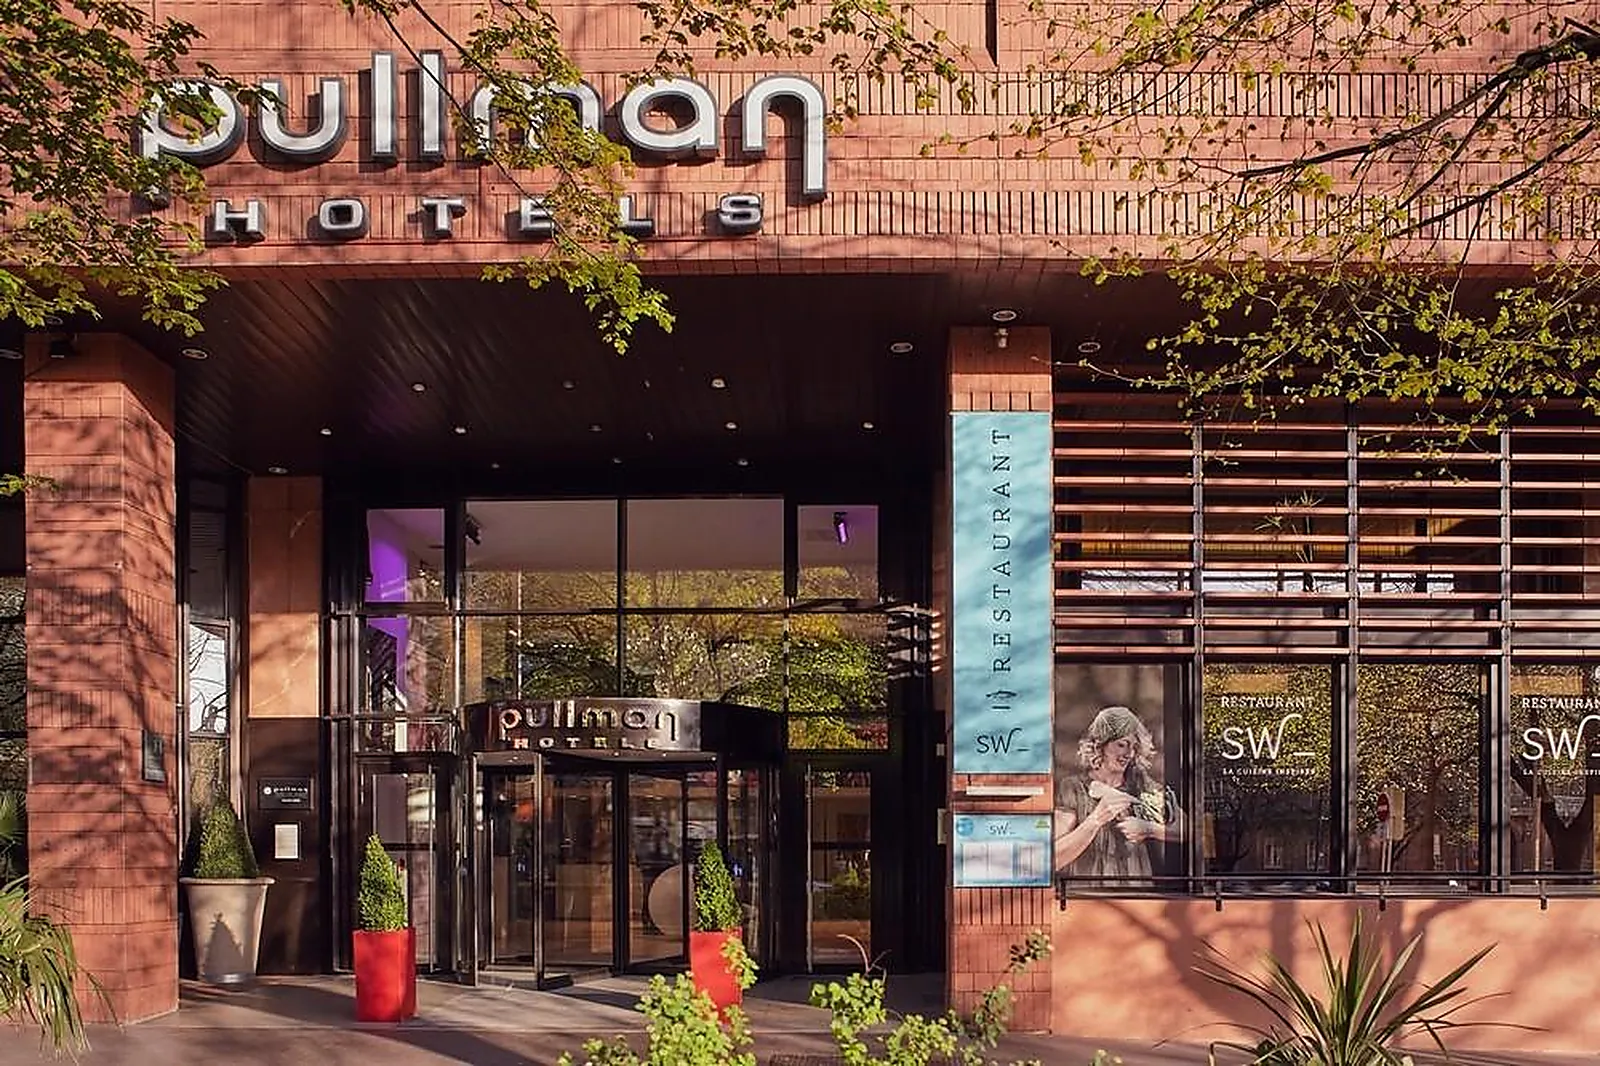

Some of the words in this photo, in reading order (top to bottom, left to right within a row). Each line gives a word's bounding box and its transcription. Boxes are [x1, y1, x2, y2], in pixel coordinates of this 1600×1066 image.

[139, 50, 826, 204] pullman
[213, 193, 763, 237] HOTELS
[992, 429, 1011, 673] RESTAURANT
[499, 699, 680, 742] pullman
[1221, 696, 1315, 709] RESTAURANT
